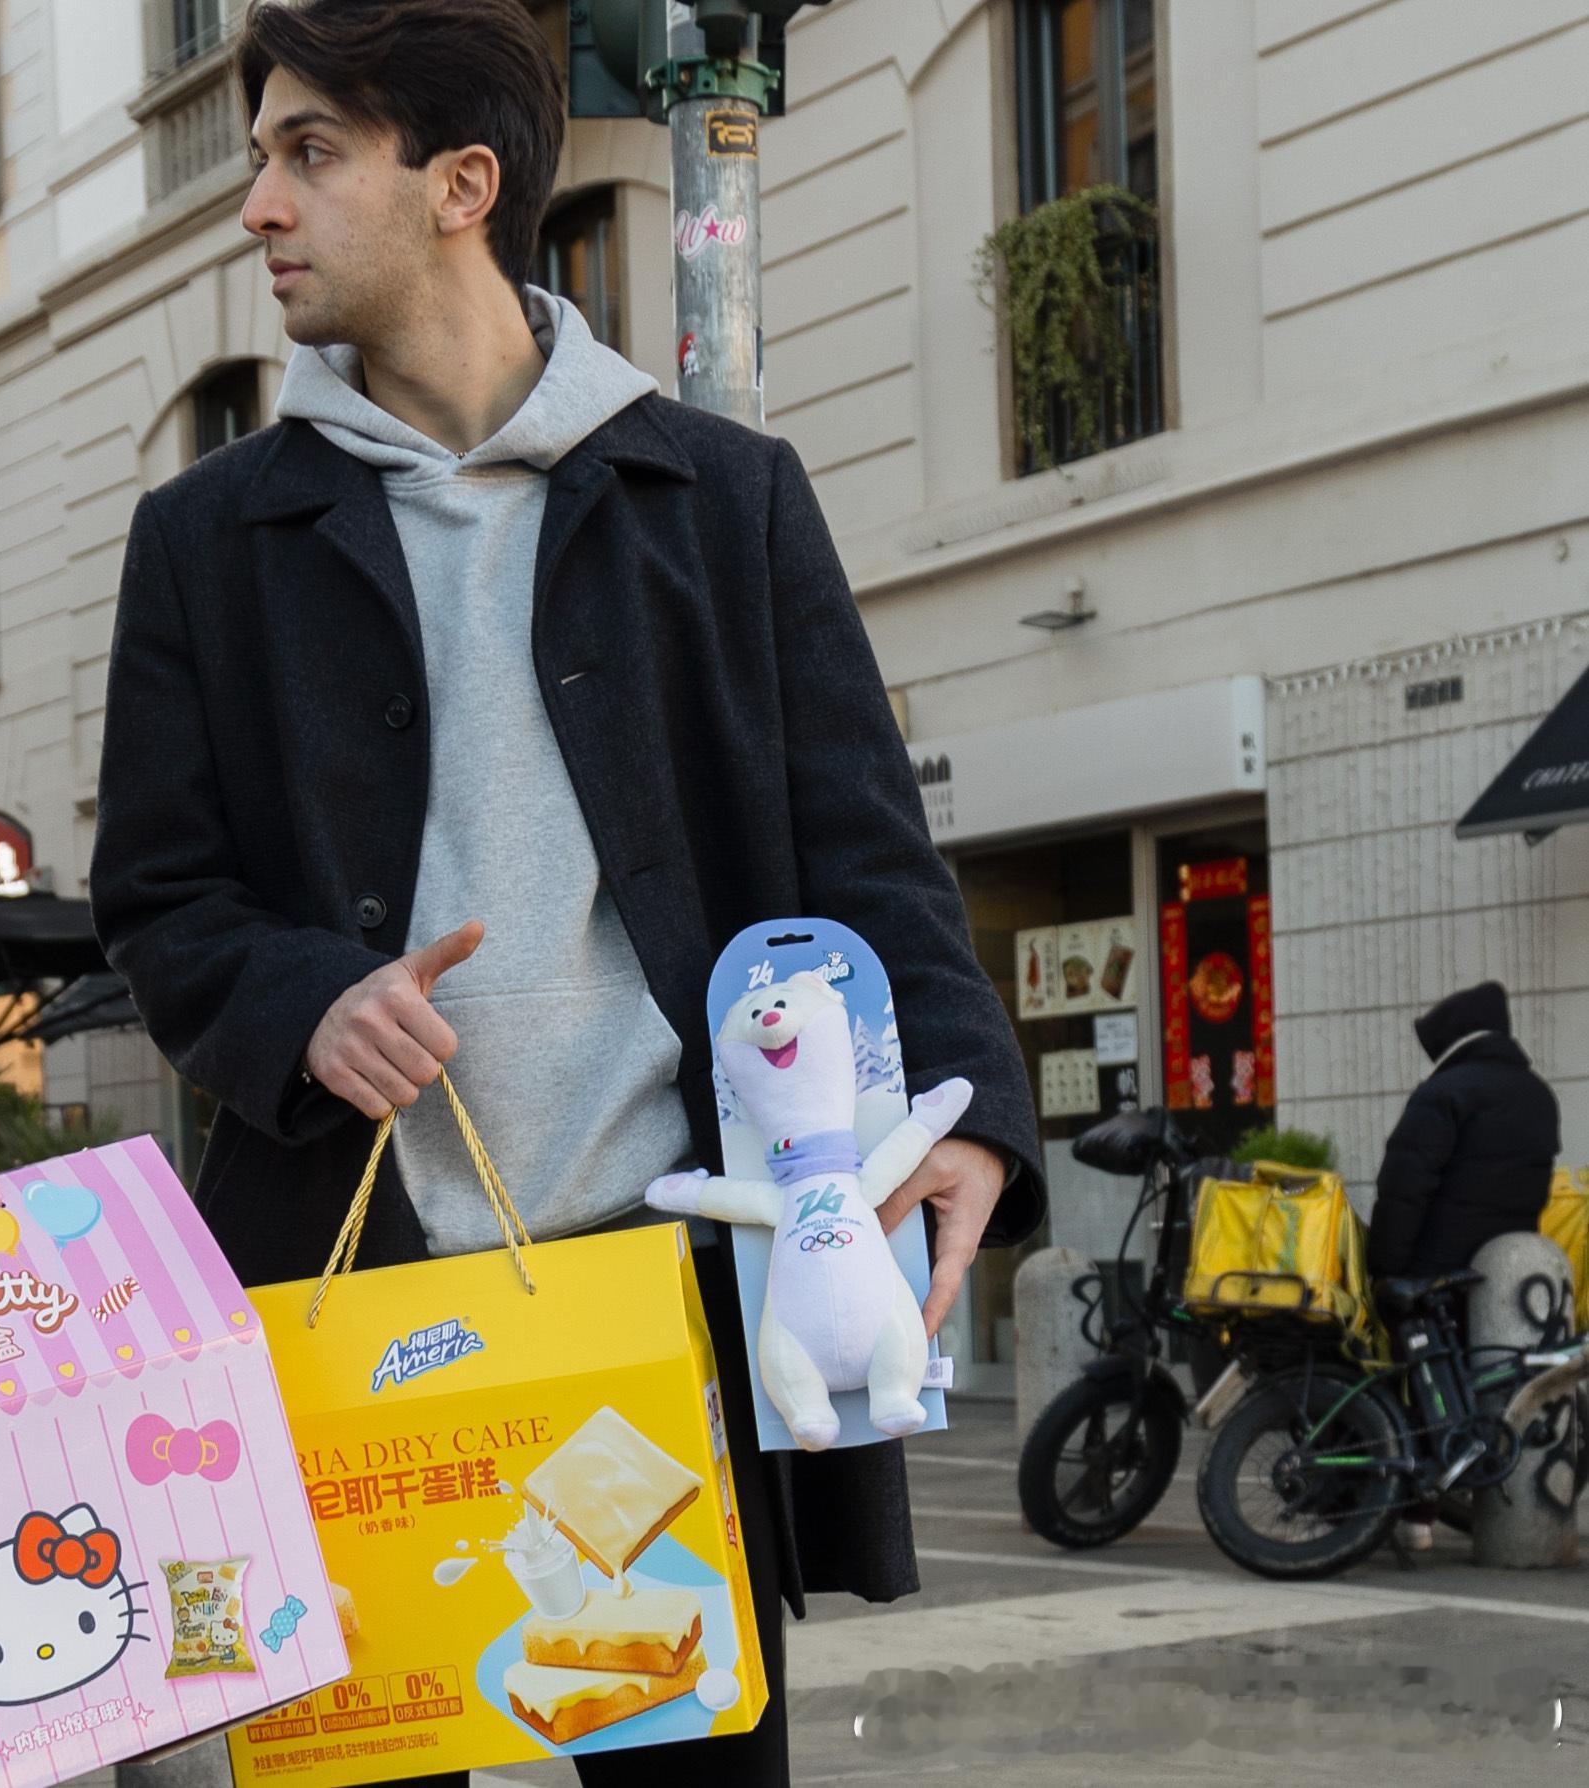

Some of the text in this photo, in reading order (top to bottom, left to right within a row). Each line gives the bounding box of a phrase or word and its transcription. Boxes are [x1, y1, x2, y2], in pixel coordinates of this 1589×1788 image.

[373, 1331, 482, 1390] Ameria
[364, 1433, 439, 1469] DRY
[453, 1416, 554, 1455] CAKE
[332, 1682, 371, 1711] 0%
[405, 1671, 444, 1700] 0%
